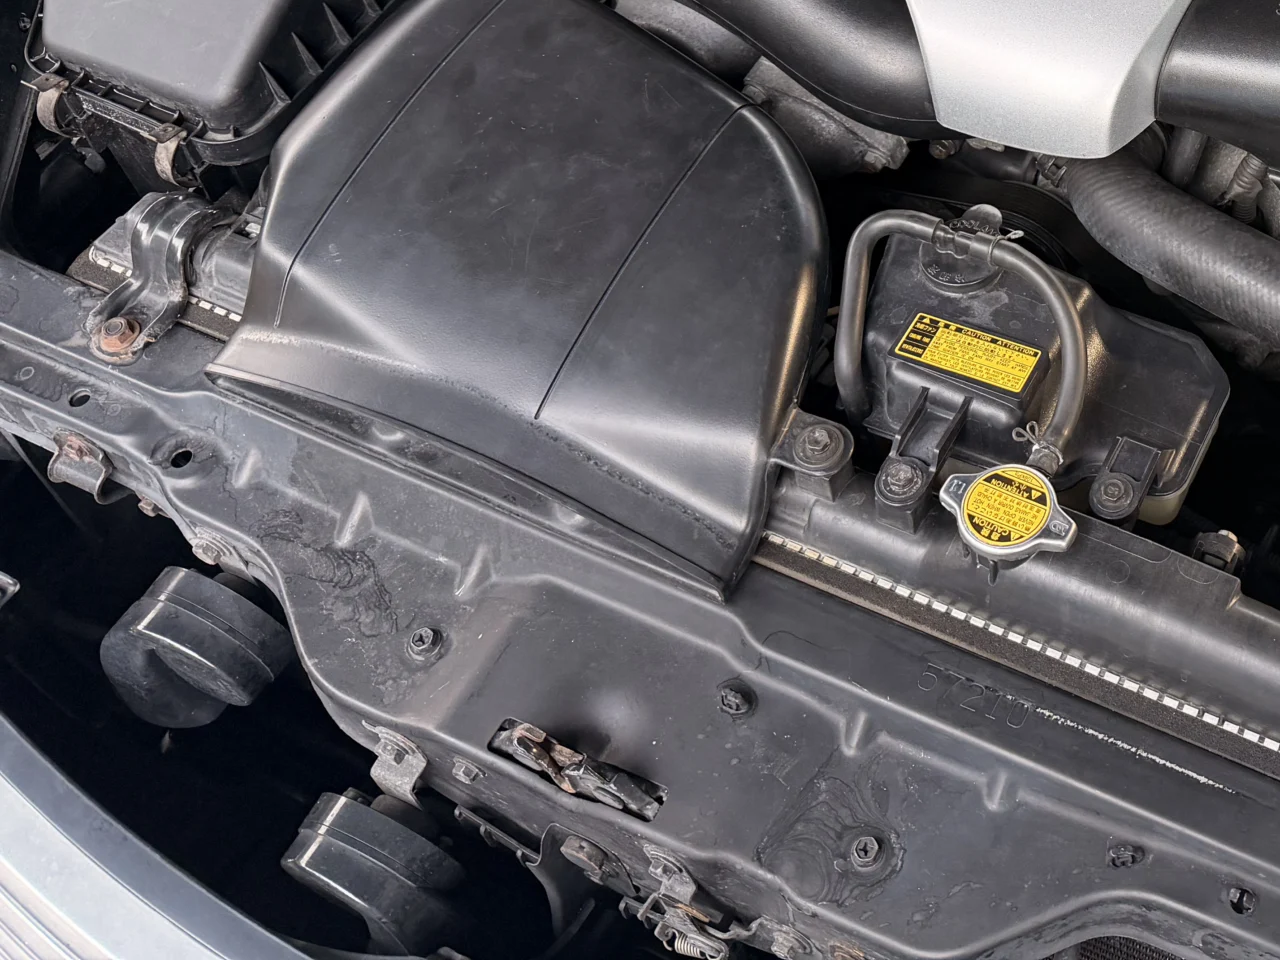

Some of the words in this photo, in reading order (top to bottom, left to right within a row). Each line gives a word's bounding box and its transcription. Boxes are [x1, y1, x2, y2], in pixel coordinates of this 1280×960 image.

[961, 329, 991, 341] CAUTION
[996, 340, 1034, 355] ATTENTION
[990, 477, 1029, 498] ATTENTION
[986, 501, 1001, 512] WHEN
[998, 499, 1014, 510] OUVRIR
[1002, 508, 1016, 519] OPEN
[1014, 506, 1030, 517] JAMAIS
[1030, 513, 1038, 521] NE
[972, 515, 1009, 536] CAUTION
[1018, 515, 1034, 526] NEVER
[915, 662, 1032, 730] 57210
